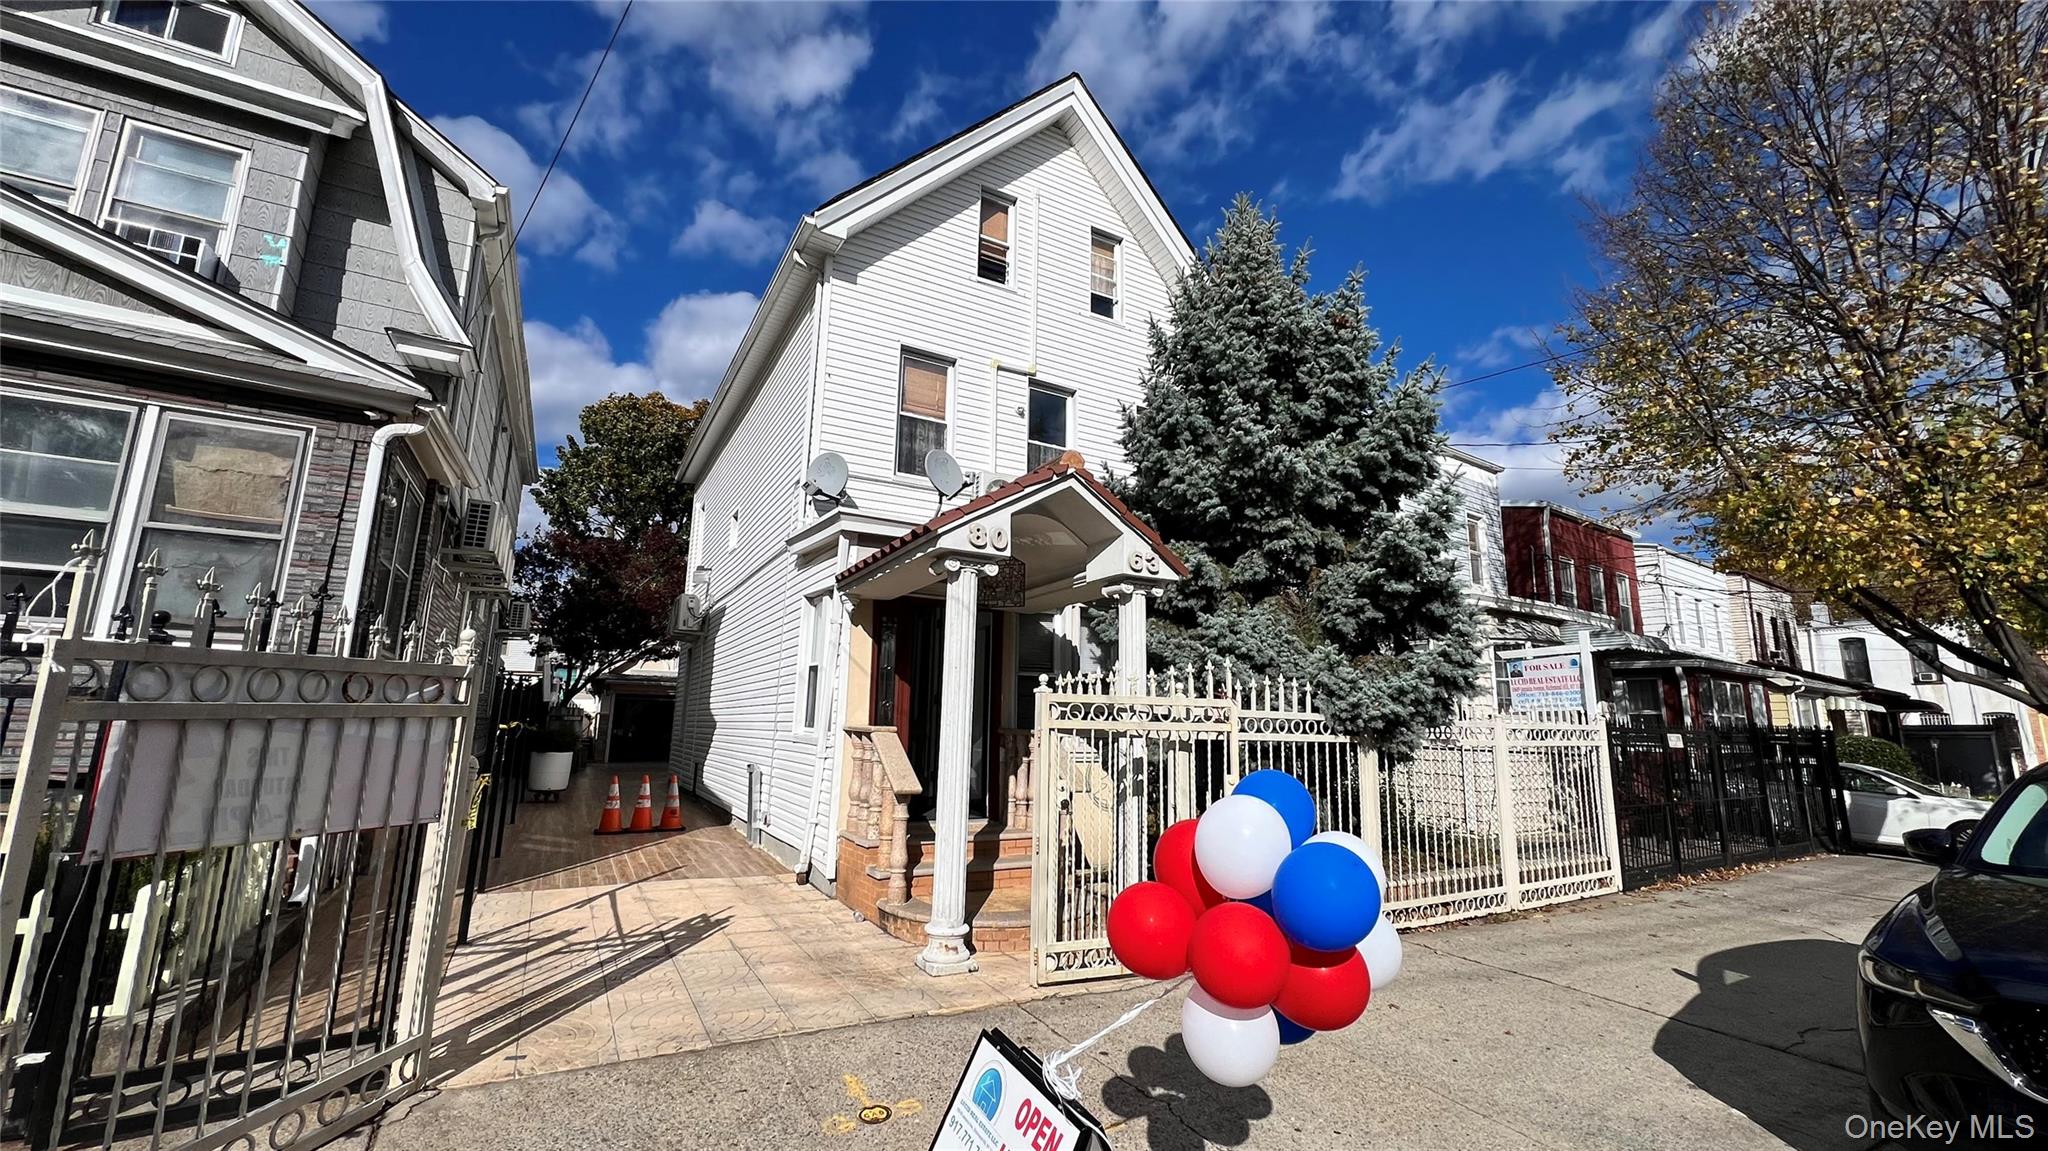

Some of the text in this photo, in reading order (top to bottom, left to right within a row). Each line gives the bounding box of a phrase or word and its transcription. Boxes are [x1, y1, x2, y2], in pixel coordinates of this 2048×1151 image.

[968, 522, 1008, 551] 80
[1128, 551, 1159, 575] 63
[1524, 662, 1566, 672] FOR SALE
[1529, 677, 1544, 685] REAL
[1545, 675, 1569, 684] ESTATE
[1015, 1098, 1064, 1151] OPEN
